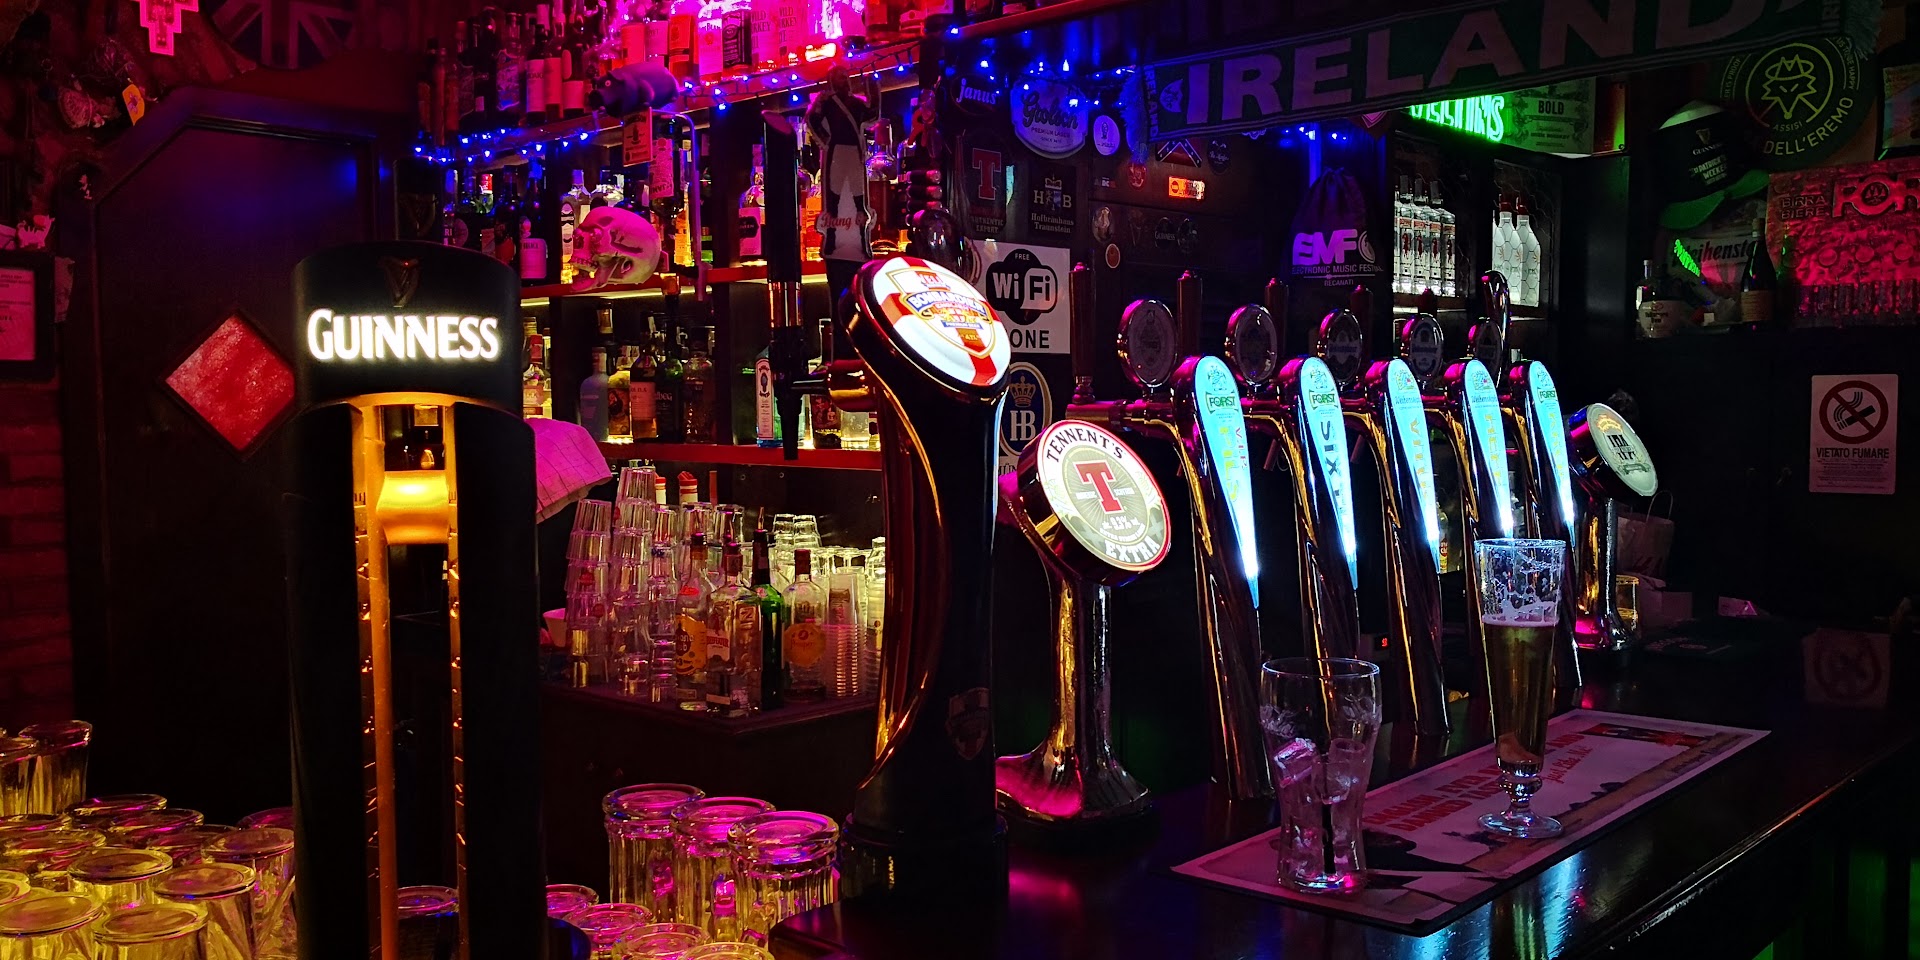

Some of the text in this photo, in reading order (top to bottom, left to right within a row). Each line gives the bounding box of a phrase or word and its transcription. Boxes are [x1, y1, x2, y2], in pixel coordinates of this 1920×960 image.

[1186, 0, 1770, 124] IRELAND
[956, 78, 997, 105] janus
[1538, 100, 1564, 115] BOLD
[1763, 97, 1855, 156] DELL'EREMO
[1773, 121, 1803, 132] ASSISI
[1781, 195, 1826, 208] BIRRA
[1015, 253, 1030, 261] FREE
[1332, 264, 1358, 274] MUSIC
[307, 309, 499, 360] GUINNESS
[1008, 329, 1050, 349] ONE
[1209, 396, 1236, 408] FORST
[1312, 393, 1336, 405] FORST
[1046, 427, 1124, 463] TENNENT'S
[1816, 447, 1890, 459] VIETATO FUMARE
[1104, 535, 1161, 563] EXTRA
